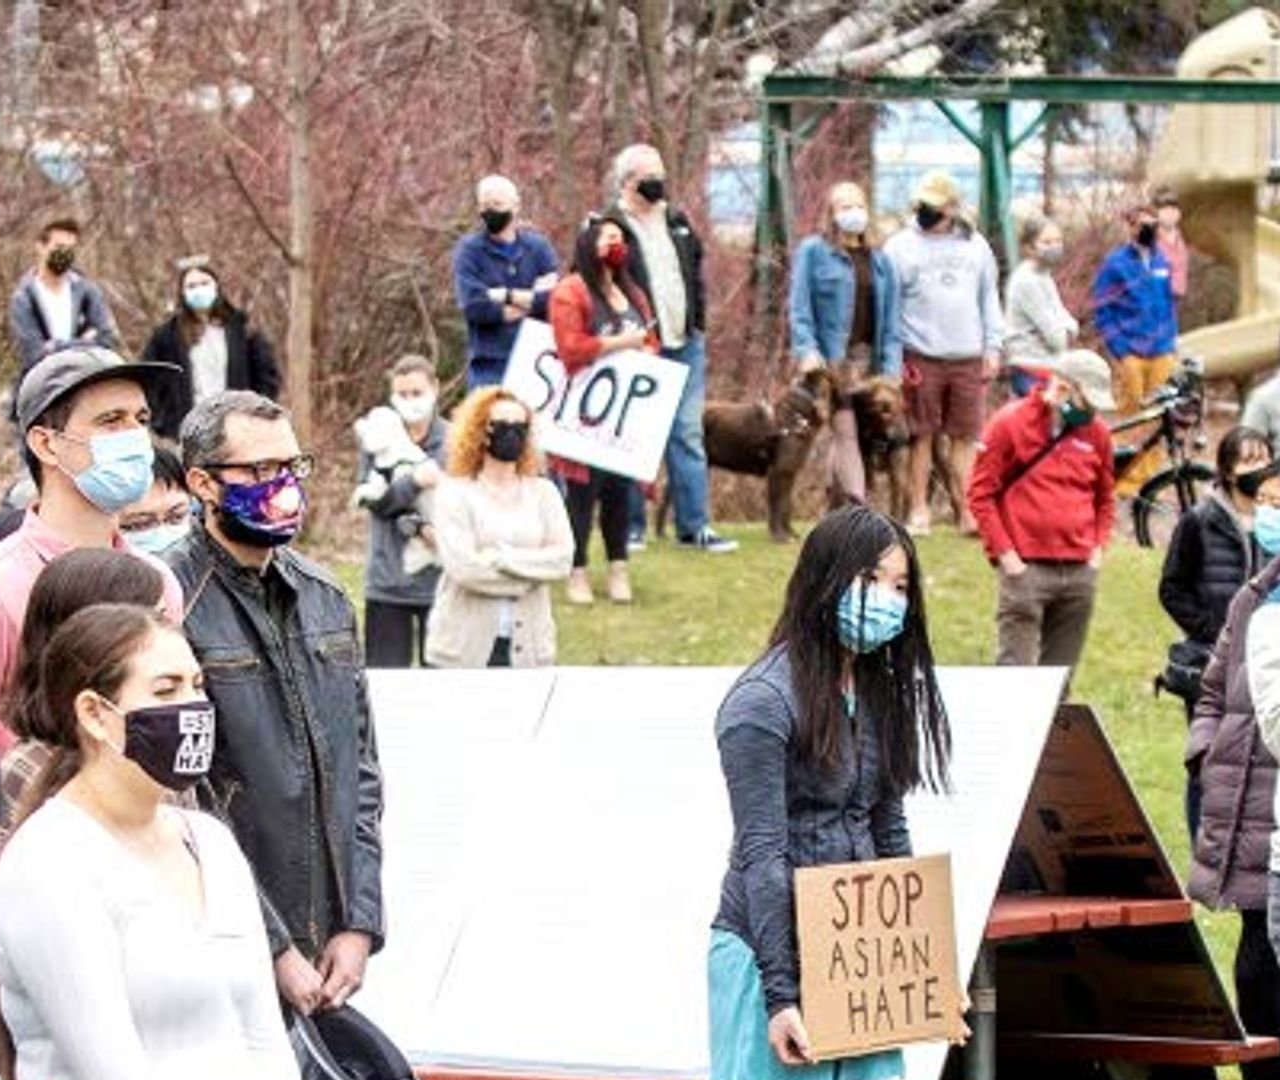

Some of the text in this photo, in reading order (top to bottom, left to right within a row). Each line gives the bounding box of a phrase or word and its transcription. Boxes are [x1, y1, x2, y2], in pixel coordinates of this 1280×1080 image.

[831, 872, 923, 932] STOP
[828, 933, 931, 982] ASIAN
[847, 976, 943, 1035] HATE
